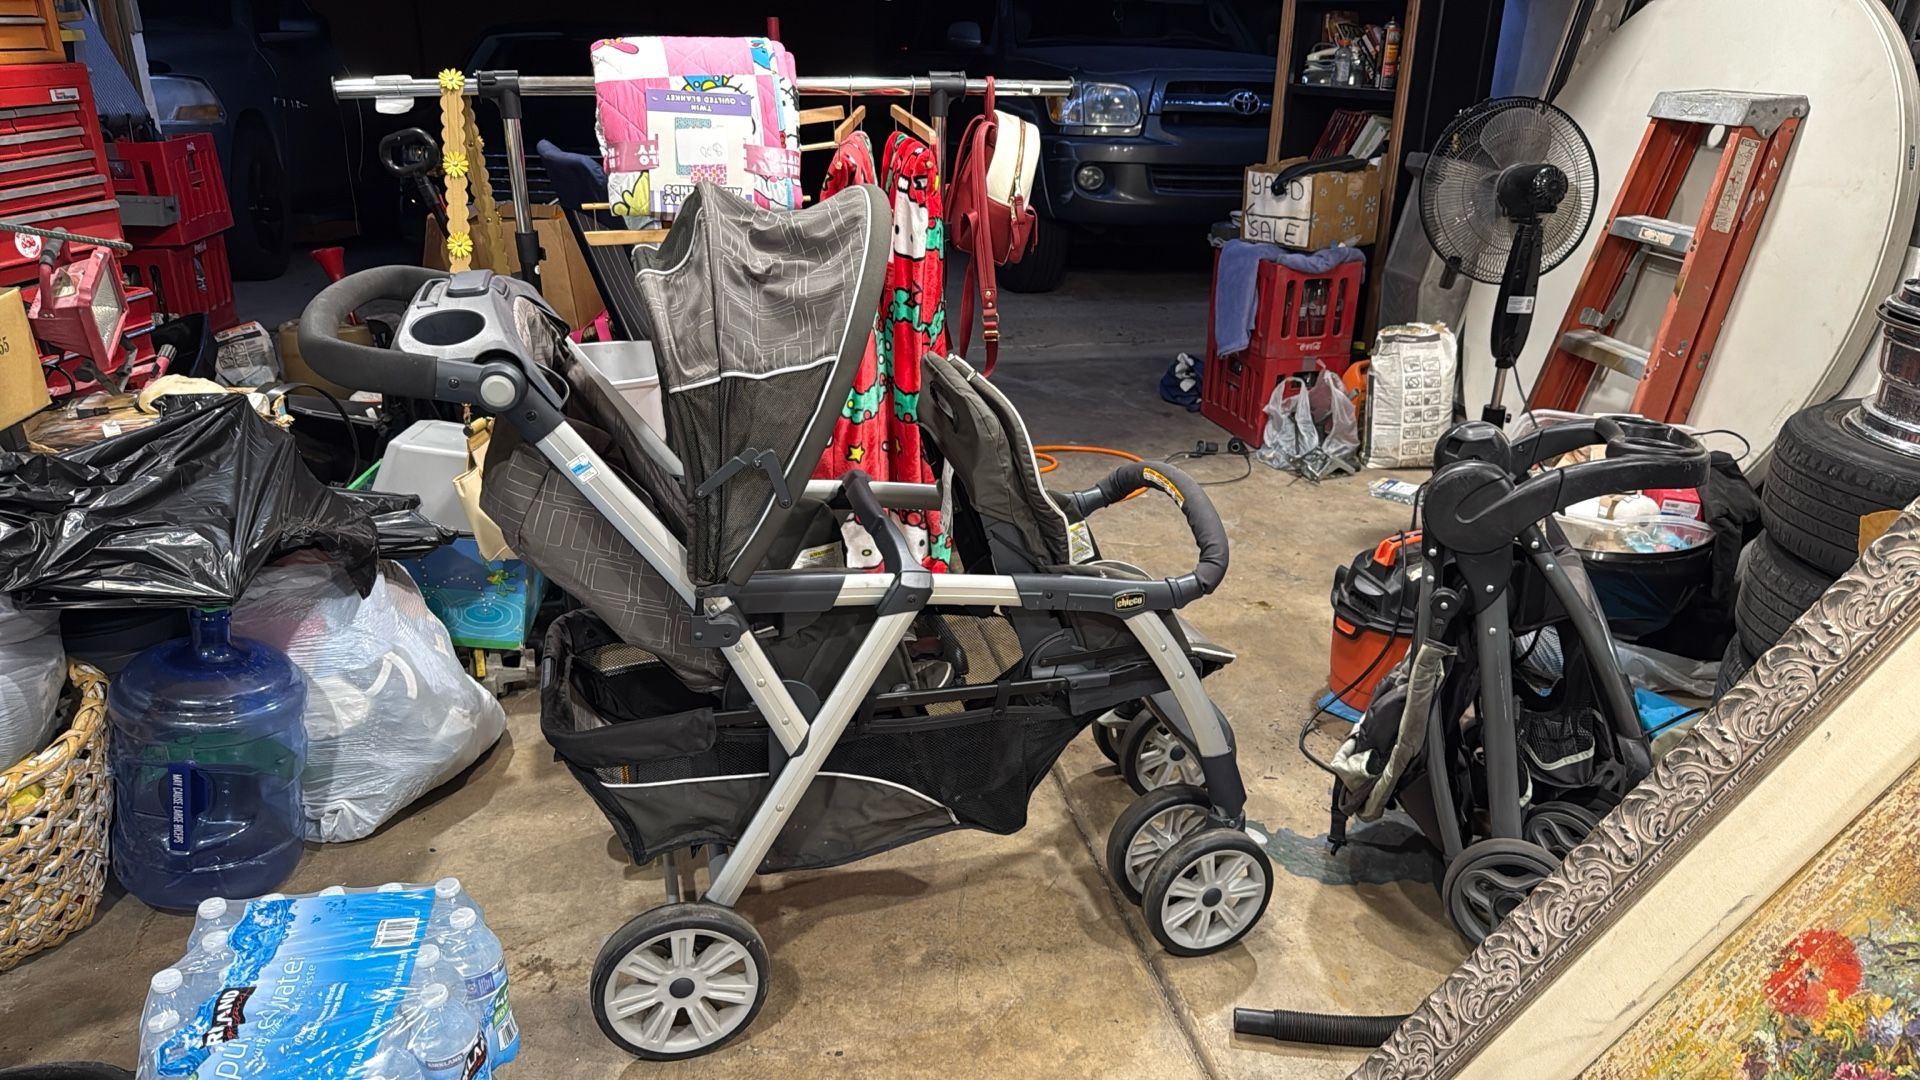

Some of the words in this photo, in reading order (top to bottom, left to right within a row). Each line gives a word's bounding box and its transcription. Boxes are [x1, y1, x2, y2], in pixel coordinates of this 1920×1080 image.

[690, 104, 712, 112] TWIN
[699, 97, 736, 105] QUILTED
[1251, 173, 1305, 201] YAD
[1248, 219, 1301, 245] SALE
[1117, 596, 1143, 608] chicco
[173, 774, 183, 787] MAY
[173, 787, 184, 806] CAUSE
[173, 806, 184, 824] LARGE
[173, 823, 184, 844] BICEPS
